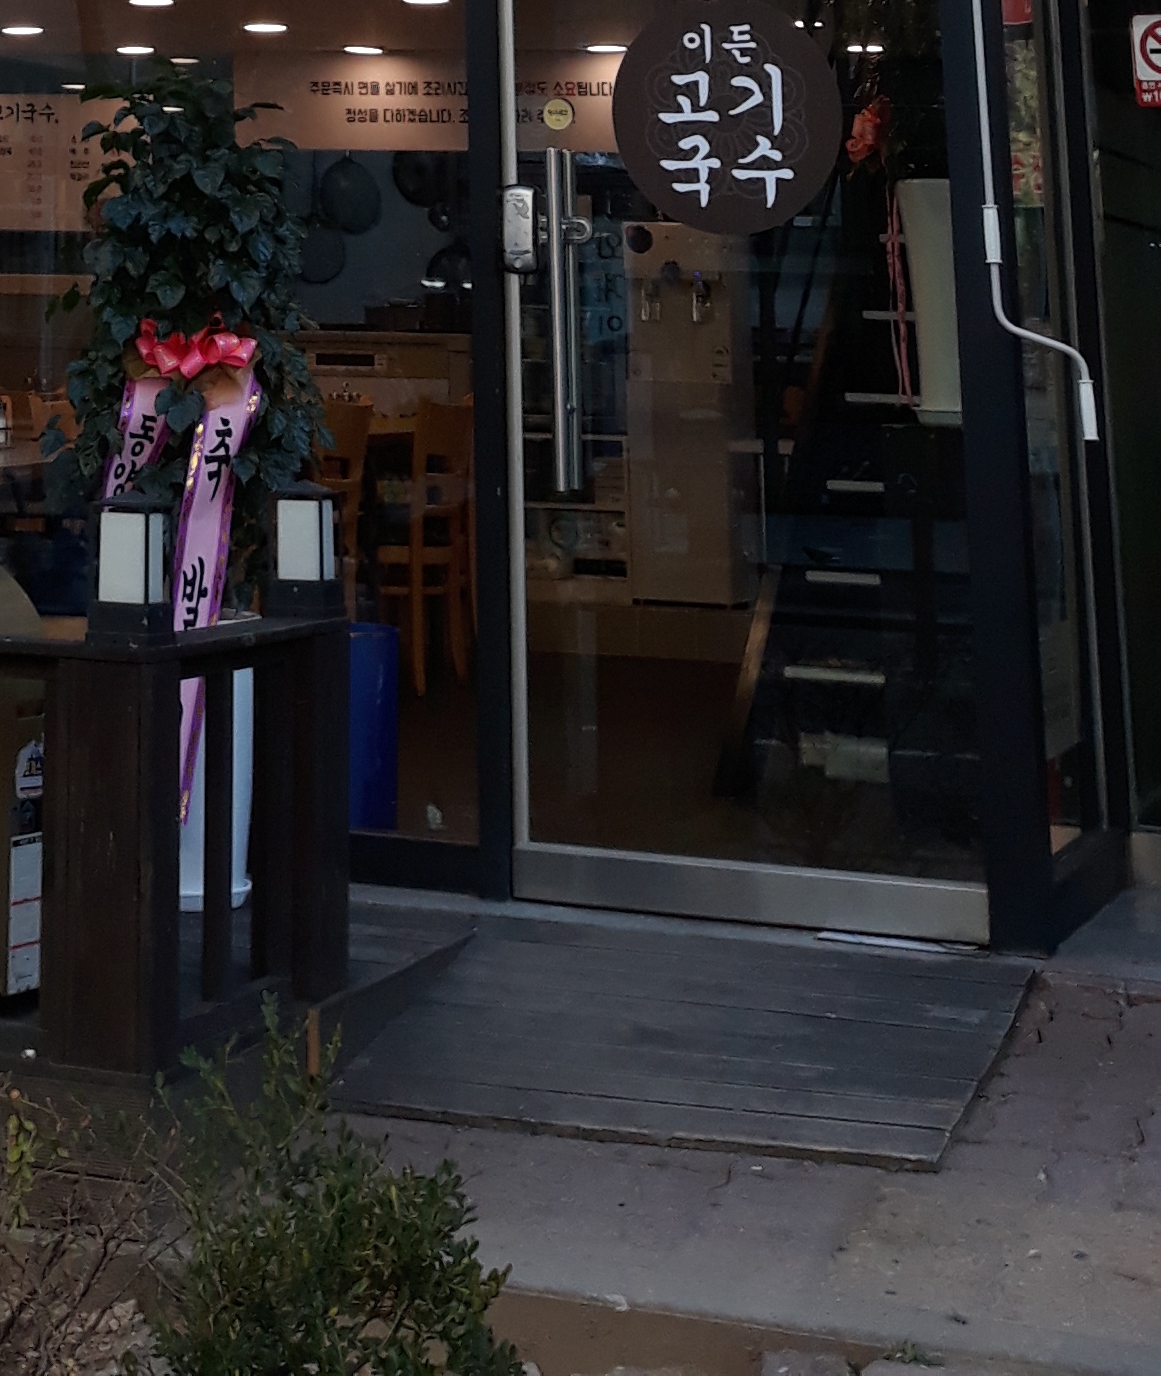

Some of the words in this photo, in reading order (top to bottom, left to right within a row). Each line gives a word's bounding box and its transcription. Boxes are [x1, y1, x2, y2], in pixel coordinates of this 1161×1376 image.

[681, 22, 758, 65] 이든
[657, 63, 783, 136] 고기
[658, 134, 795, 210] 국수
[203, 416, 233, 501] 축
